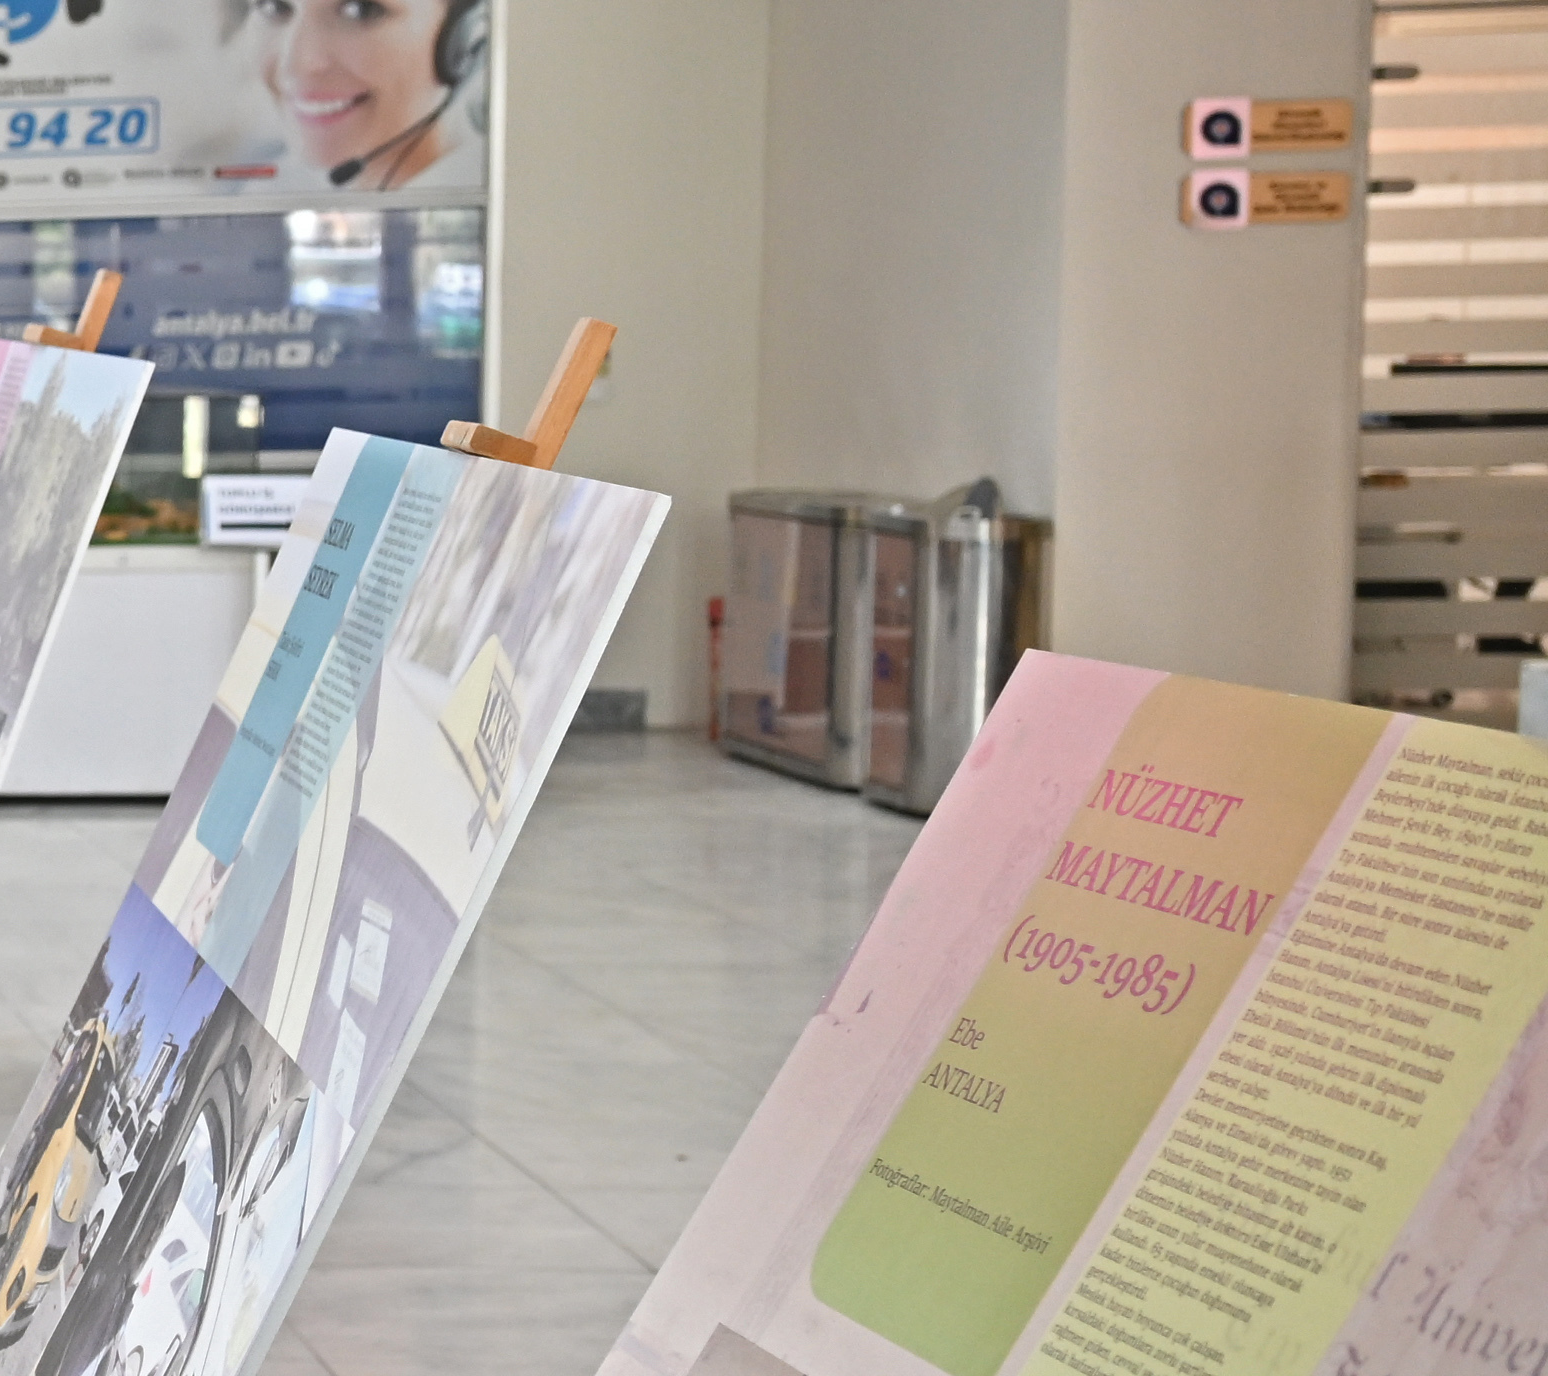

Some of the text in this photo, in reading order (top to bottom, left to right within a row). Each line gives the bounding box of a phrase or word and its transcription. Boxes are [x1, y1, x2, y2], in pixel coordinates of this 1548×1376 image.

[6, 109, 69, 149] 94
[84, 107, 148, 146] 20
[1087, 764, 1244, 837] NÜZHET
[1045, 841, 1275, 936] MAYTALMAN
[1003, 914, 1196, 1015] (1905-1985)
[949, 1018, 985, 1050] Ebe
[922, 1062, 1006, 1113] ANTALYA
[928, 1186, 990, 1230] Maytalman
